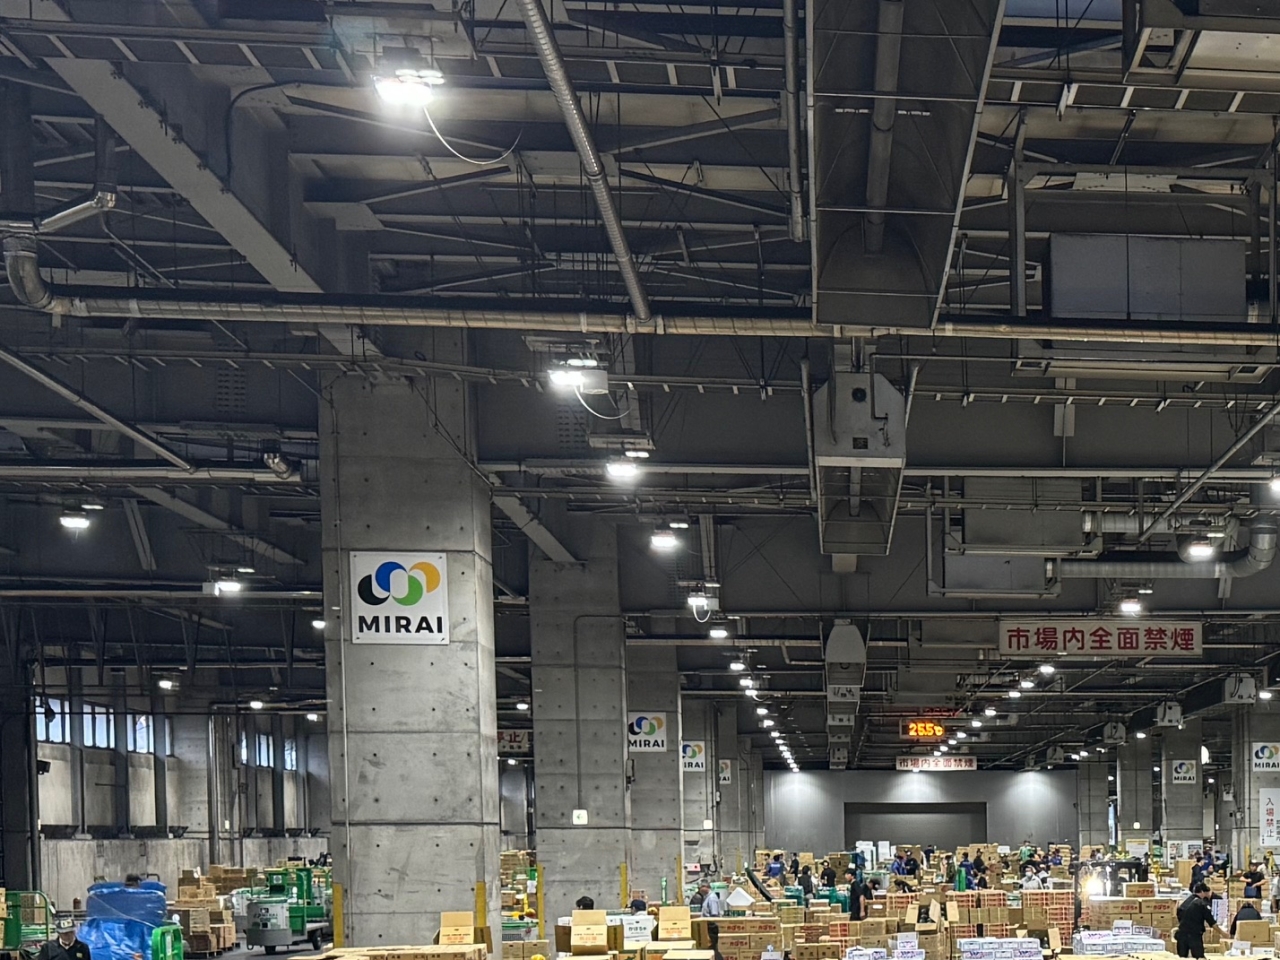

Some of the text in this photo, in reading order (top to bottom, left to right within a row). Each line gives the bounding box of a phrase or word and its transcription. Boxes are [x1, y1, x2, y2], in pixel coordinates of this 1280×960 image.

[358, 616, 442, 633] MIRAI
[1007, 628, 1195, 650] 市場内全面禁煙
[629, 740, 664, 748] MIRAI
[900, 759, 974, 768] 市場内全面禁煙
[1266, 797, 1274, 837] 入場禁止
